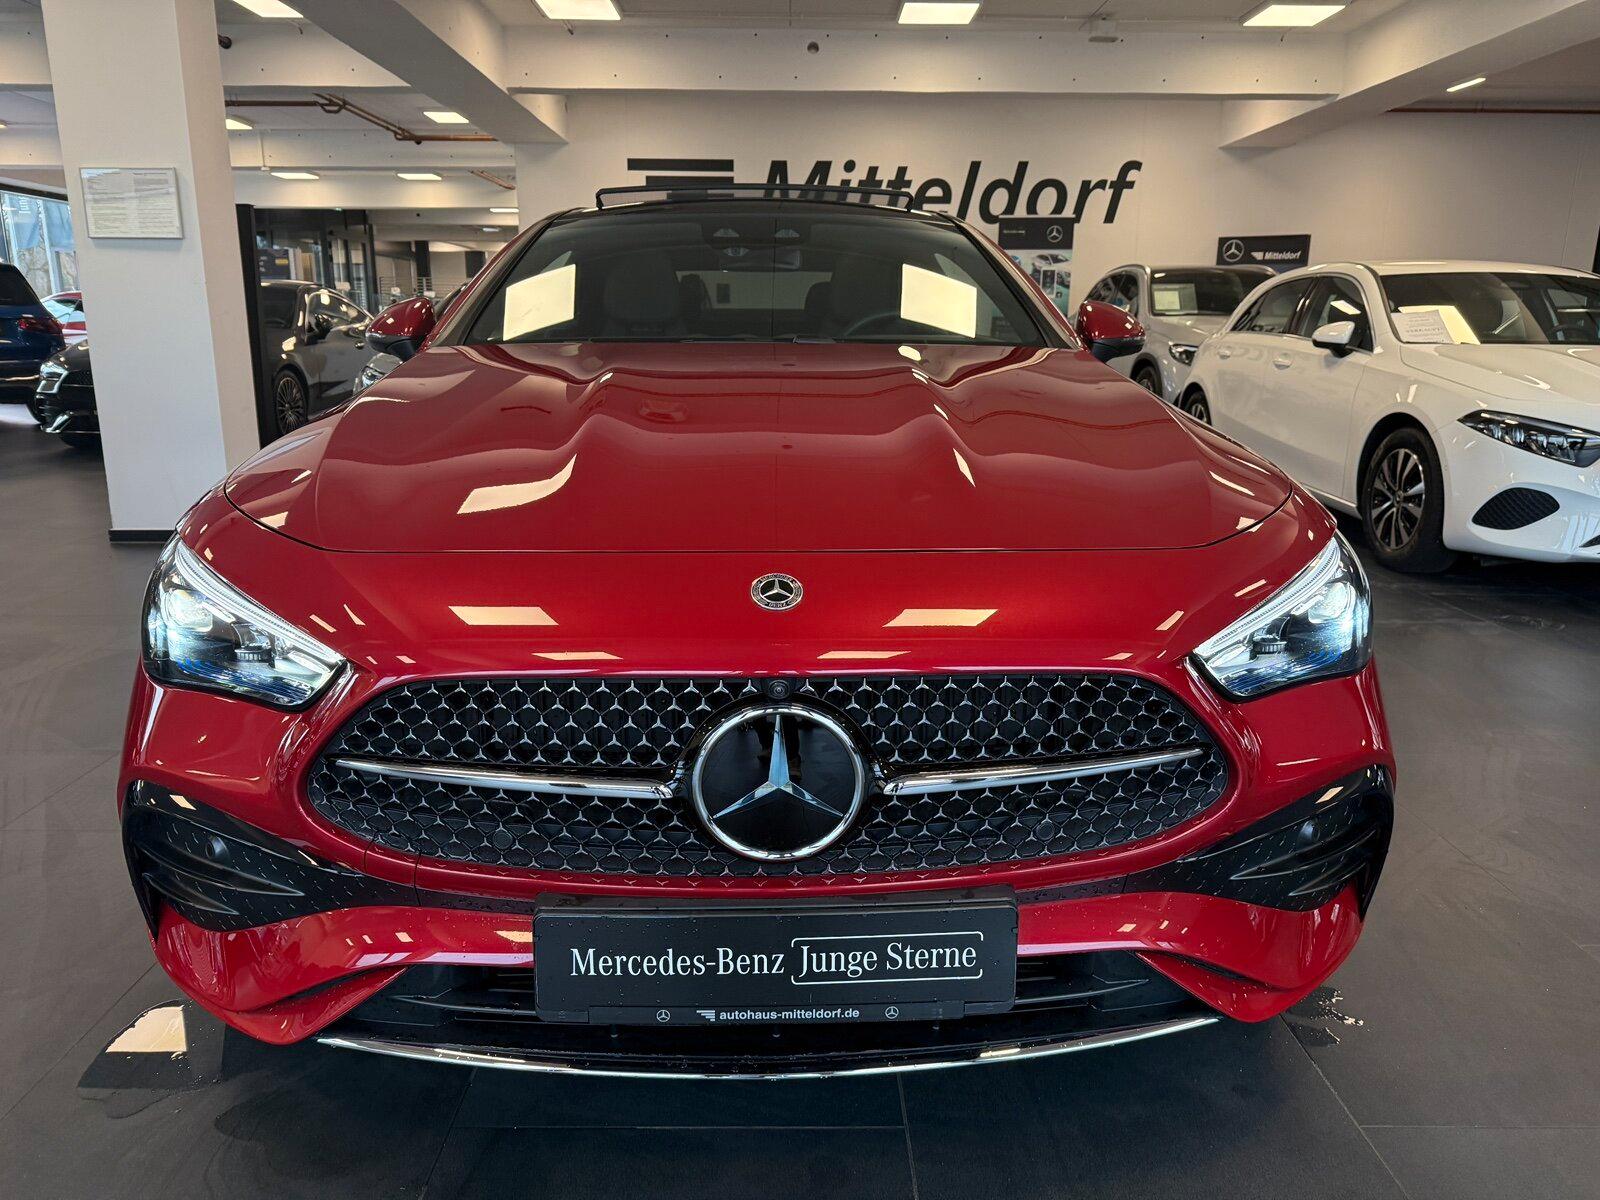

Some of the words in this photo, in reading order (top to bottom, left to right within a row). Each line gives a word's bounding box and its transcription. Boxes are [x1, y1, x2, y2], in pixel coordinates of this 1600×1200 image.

[763, 159, 1143, 224] Mitteldorf
[1263, 250, 1302, 260] Mitteldorf
[570, 947, 785, 976] Mercedes-Benz
[799, 945, 878, 978] Junge
[886, 942, 977, 971] Sterne
[719, 1008, 860, 1020] autohaus-mitteldorf.de
